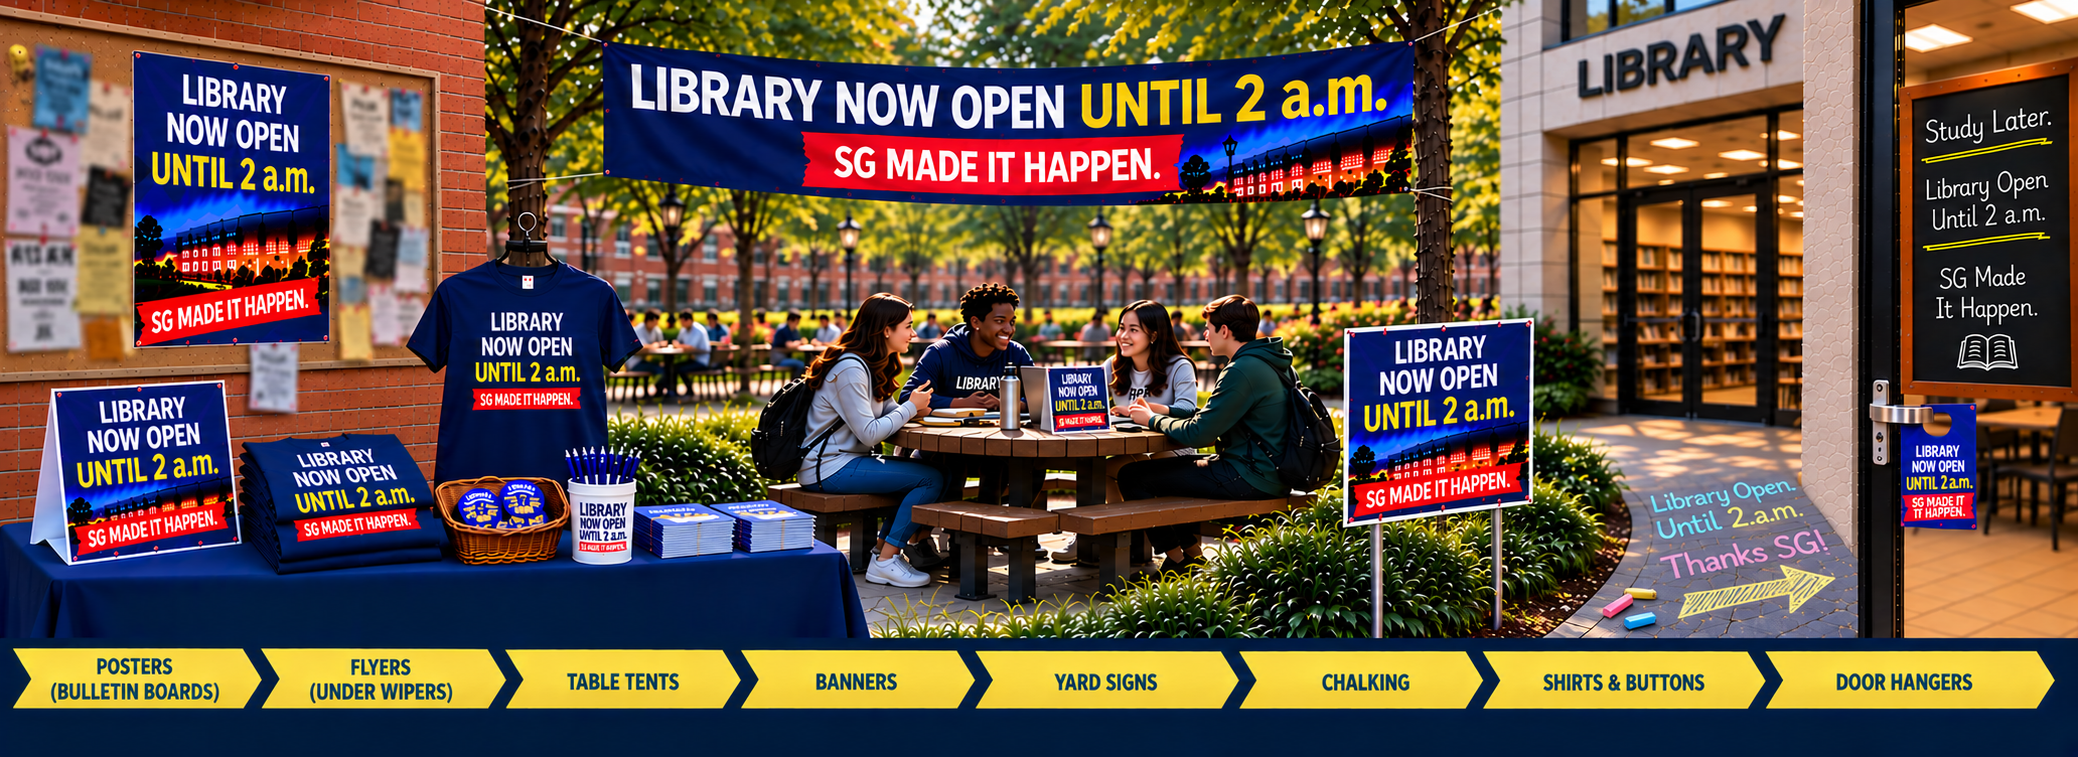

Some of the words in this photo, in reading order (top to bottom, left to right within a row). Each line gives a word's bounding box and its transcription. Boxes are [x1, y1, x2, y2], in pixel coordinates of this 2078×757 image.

[1578, 13, 1786, 99] LIBRARY
[182, 73, 287, 114] LIBRARY
[630, 63, 823, 123] LIBRARY
[836, 81, 940, 128] NOW
[951, 85, 1065, 130] OPEN
[1081, 77, 1222, 129] UNTIL
[1234, 73, 1266, 123] 2
[1281, 73, 1388, 120] a.m.
[166, 112, 228, 148] NOW
[235, 118, 300, 153] OPEN
[1925, 113, 1984, 144] Study
[1992, 107, 2053, 134] Later.
[151, 151, 235, 189] UNTIL
[240, 157, 258, 191] 2
[262, 163, 316, 195] a.m.
[833, 145, 877, 179] SG
[886, 148, 979, 183] MADE
[988, 151, 1016, 183] IT
[1024, 147, 1161, 183] HAPPEN.
[1925, 177, 1990, 202] Library
[1996, 170, 2050, 200] Open
[1932, 204, 1978, 231] Until
[1984, 203, 1998, 227] 2
[2004, 206, 2046, 226] a.m.
[1939, 266, 1968, 290] SG
[1975, 264, 2027, 289] Made
[151, 309, 173, 334] SG
[177, 300, 224, 330] MADE
[227, 298, 242, 320] IT
[244, 288, 309, 317] HAPPEN.
[490, 312, 563, 331] LIBRARY
[1935, 296, 1954, 320] It
[1961, 296, 2039, 326] Happen.
[481, 336, 523, 356] NOW
[528, 336, 573, 356] OPEN
[1395, 335, 1486, 365] LIBRARY
[475, 362, 526, 382] UNTIL
[530, 361, 541, 382] 2
[545, 364, 580, 382] a.m.
[1379, 367, 1434, 396] NOW
[1440, 363, 1498, 391] OPEN
[98, 396, 186, 424] LIBRARY
[480, 393, 493, 406] SG
[494, 393, 522, 406] MADE
[523, 393, 532, 405] IT
[533, 392, 573, 406] HAPPEN.
[1364, 399, 1436, 432] UNTIL
[1442, 396, 1458, 425] 2
[1464, 395, 1515, 422] a.m.
[87, 427, 140, 453] NOW
[146, 422, 201, 449] OPEN
[1915, 445, 1960, 458] LIBRARY
[76, 457, 148, 488] UNTIL
[152, 453, 167, 481] 2
[173, 453, 219, 479] a.m.
[296, 449, 374, 468] LIBRARY
[1911, 460, 1936, 473] NOW
[1938, 459, 1965, 473] OPEN
[292, 469, 341, 488] NOW
[345, 464, 398, 483] OPEN
[1365, 489, 1386, 508] SG
[1389, 483, 1432, 506] MADE
[1435, 479, 1449, 498] IT
[1450, 471, 1511, 496] HAPPEN.
[1906, 476, 1938, 490] UNTIL
[1940, 475, 1948, 490] 2
[1949, 476, 1974, 489] a.m.
[294, 489, 355, 513] UNTIL
[356, 486, 371, 508] 2
[374, 486, 416, 506] a.m.
[1651, 490, 1731, 514] Library
[1733, 480, 1798, 504] Open.
[1911, 497, 1924, 507] SG
[1926, 495, 1954, 507] MADE
[1955, 495, 1965, 506] IT
[1925, 506, 1966, 518] HAPPEN.
[87, 529, 106, 548] SG
[109, 520, 149, 544] MADE
[150, 518, 161, 536] IT
[164, 510, 218, 534] HAPPEN.
[303, 523, 319, 537] SG
[321, 517, 353, 535] MADE
[354, 517, 364, 531] IT
[365, 513, 411, 530] HAPPEN.
[1656, 510, 1723, 540] Until
[1660, 543, 1769, 580] Thanks
[1773, 528, 1831, 560] SG!
